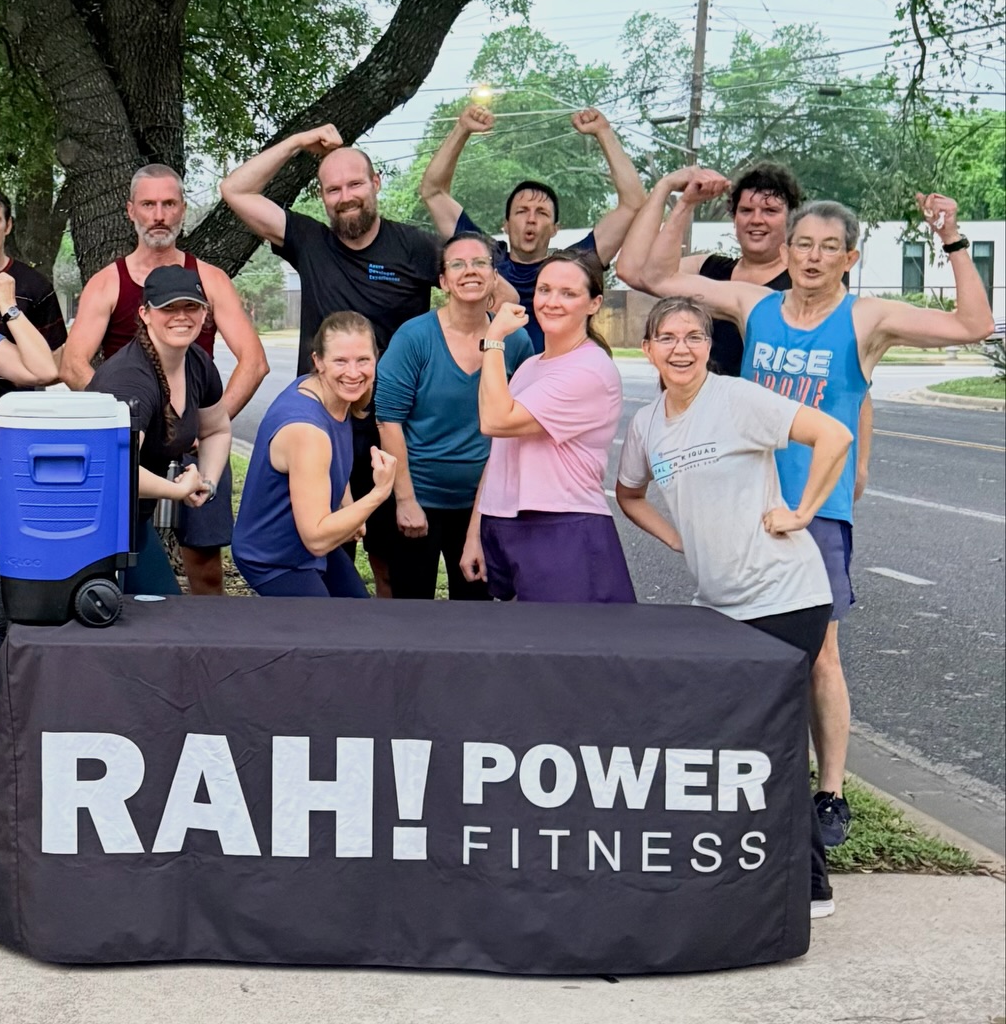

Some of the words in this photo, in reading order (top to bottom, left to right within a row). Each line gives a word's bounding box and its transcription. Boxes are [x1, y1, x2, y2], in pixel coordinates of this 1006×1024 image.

[753, 341, 833, 377] RISE
[41, 731, 432, 860] RAH!
[462, 741, 773, 812] POWER
[462, 826, 768, 872] FITNESS
